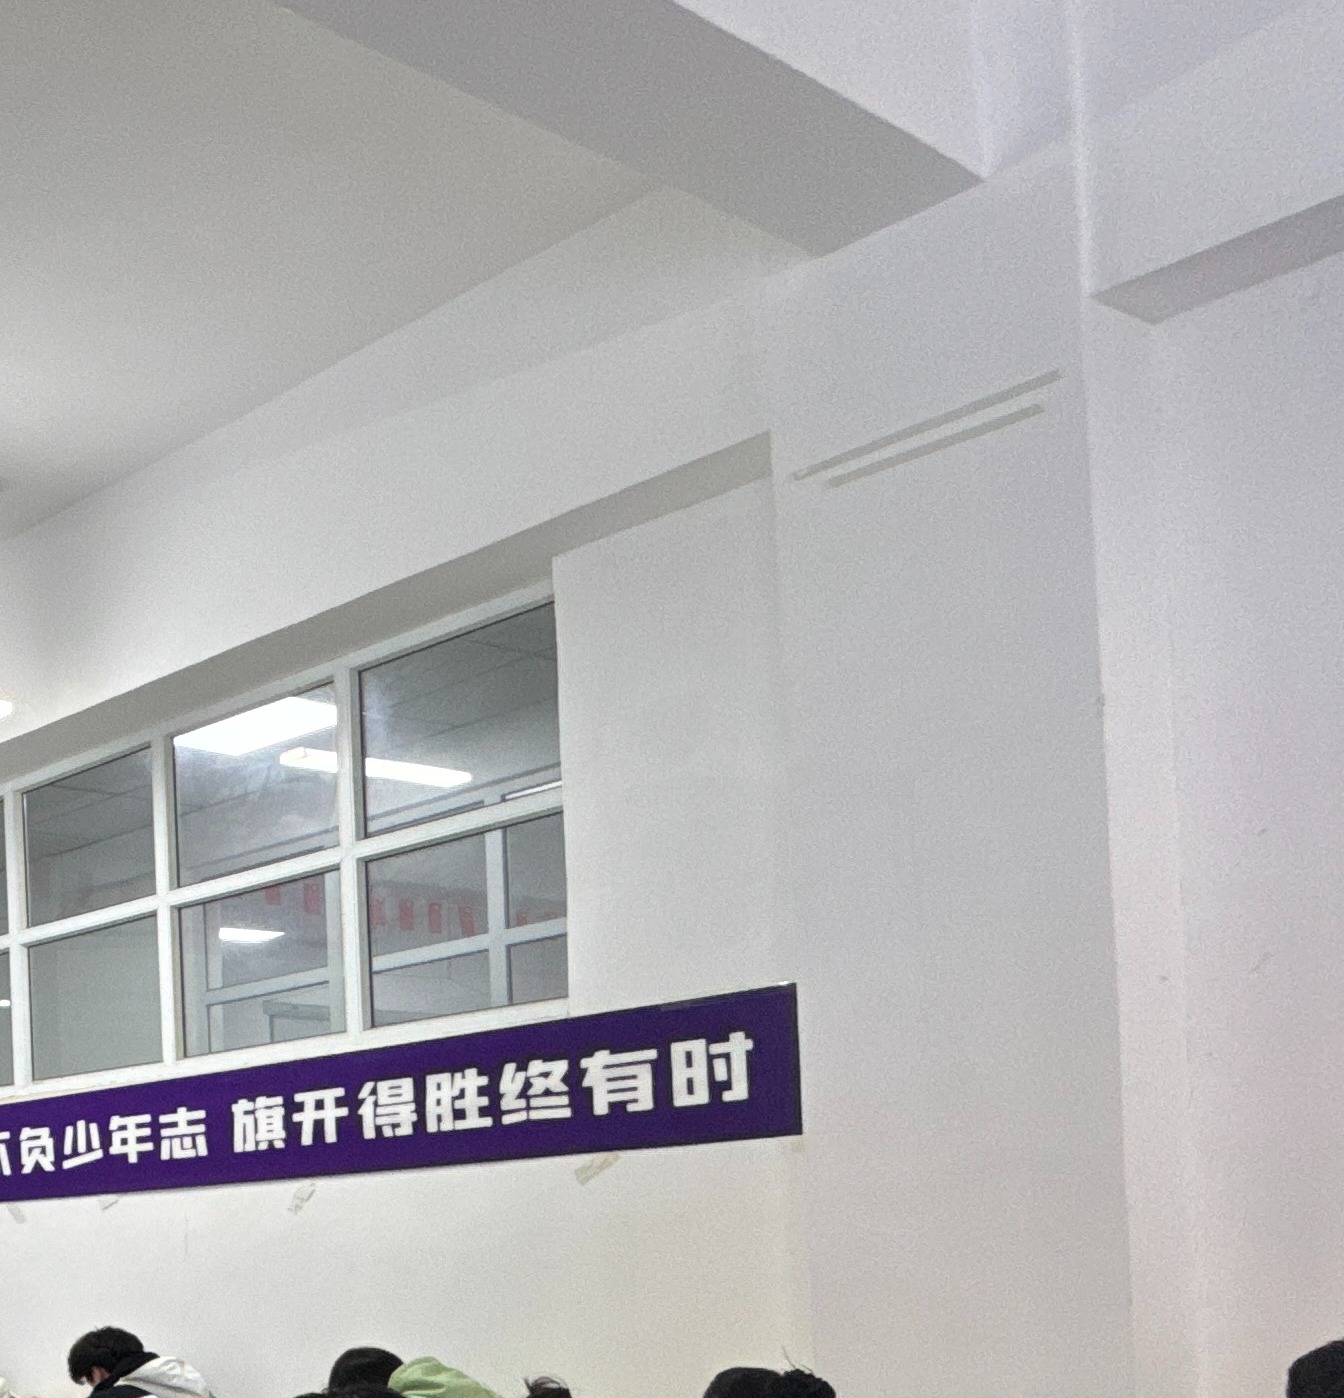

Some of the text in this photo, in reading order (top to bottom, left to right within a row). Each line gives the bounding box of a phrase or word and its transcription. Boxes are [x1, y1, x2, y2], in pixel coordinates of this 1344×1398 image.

[231, 1031, 754, 1153] 旗开得胜终有时
